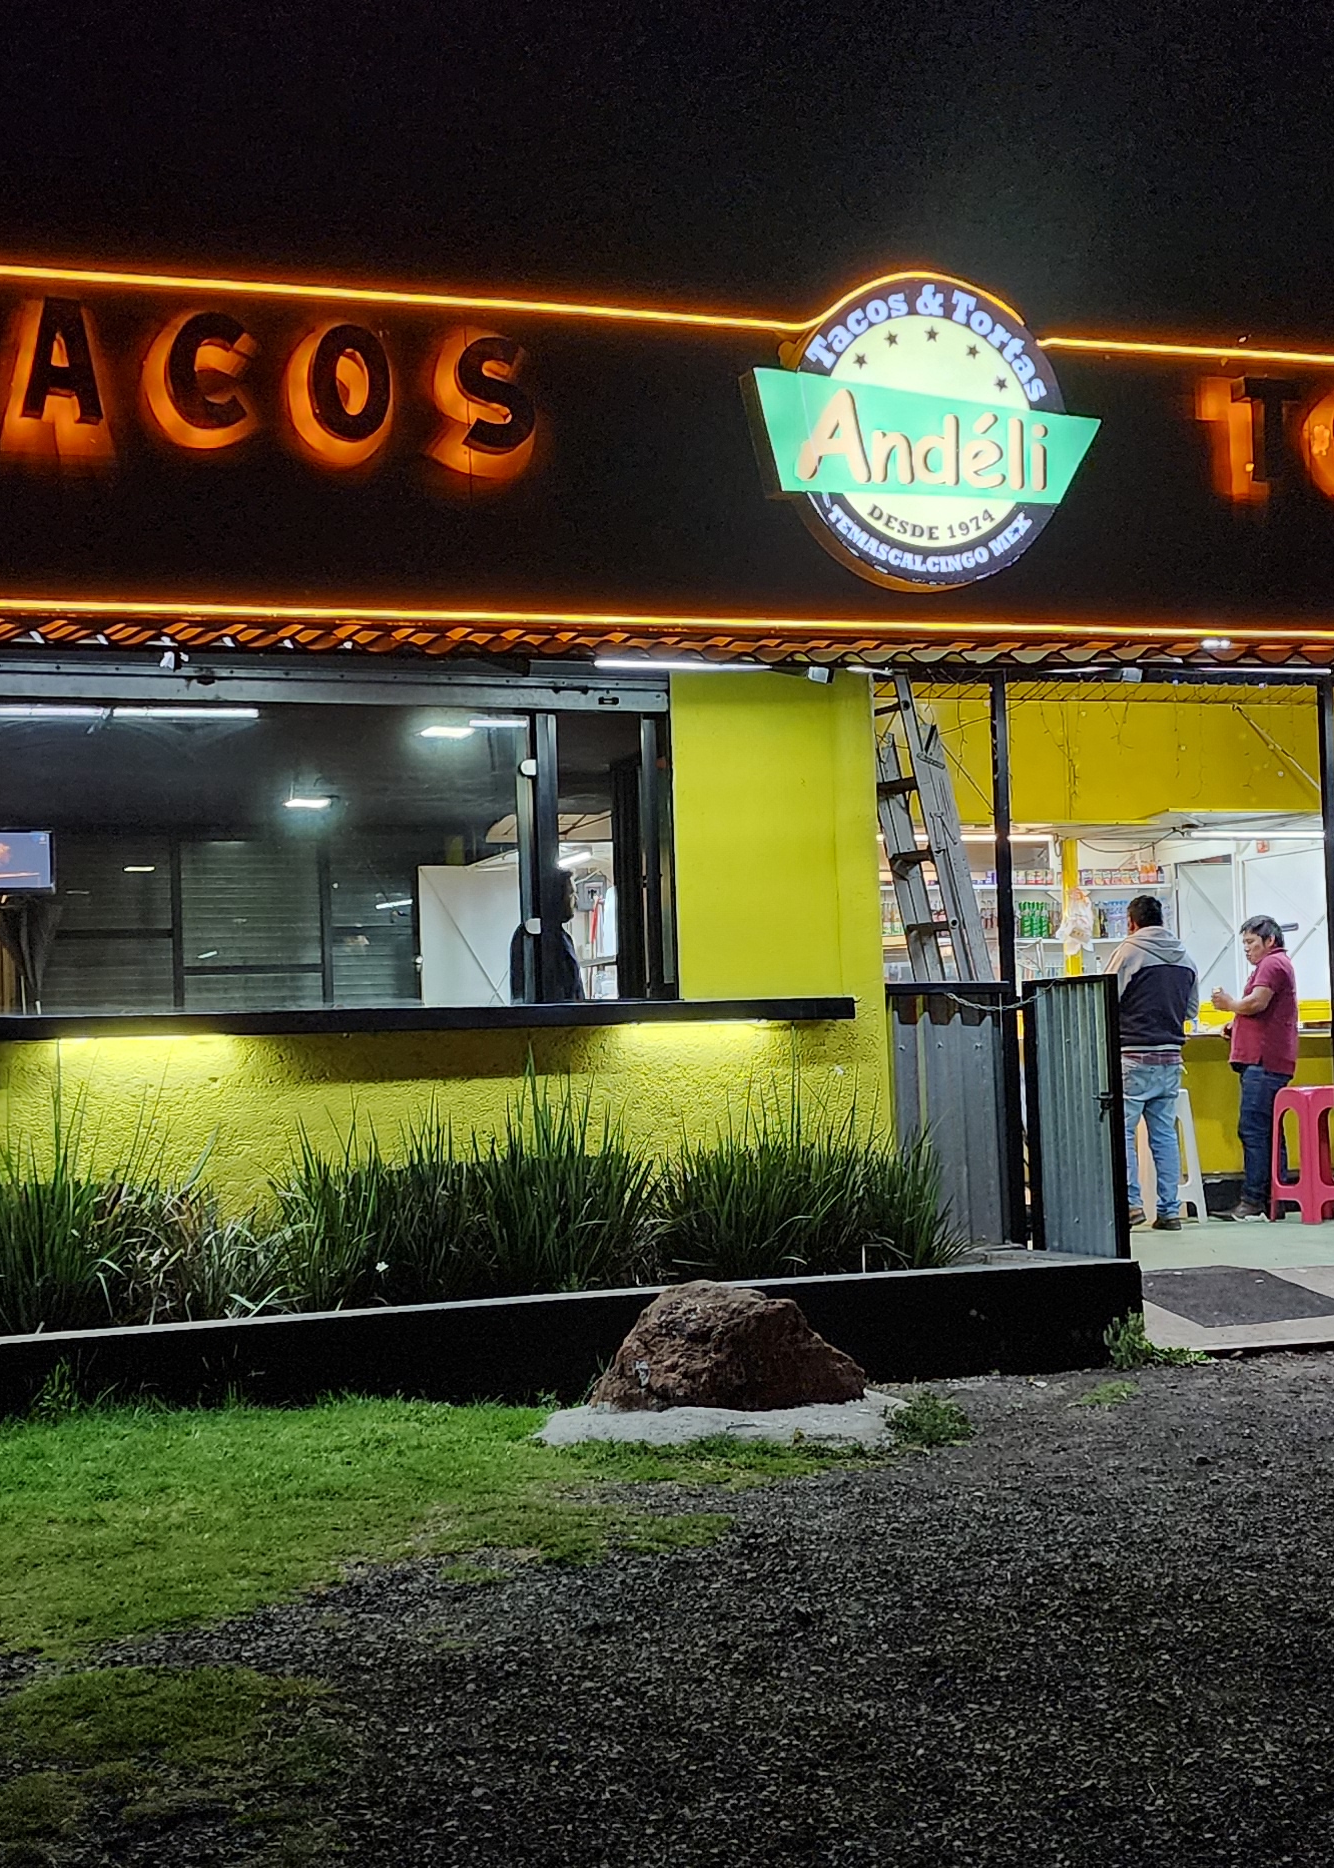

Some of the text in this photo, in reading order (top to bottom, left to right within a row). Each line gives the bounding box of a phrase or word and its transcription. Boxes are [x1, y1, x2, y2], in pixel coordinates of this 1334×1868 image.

[805, 284, 1048, 402] Tacos & Tortas
[795, 388, 1049, 492] Andéli
[827, 503, 1033, 573] TEMASCALCINGO MEX
[867, 503, 997, 541] DESDE 1974
